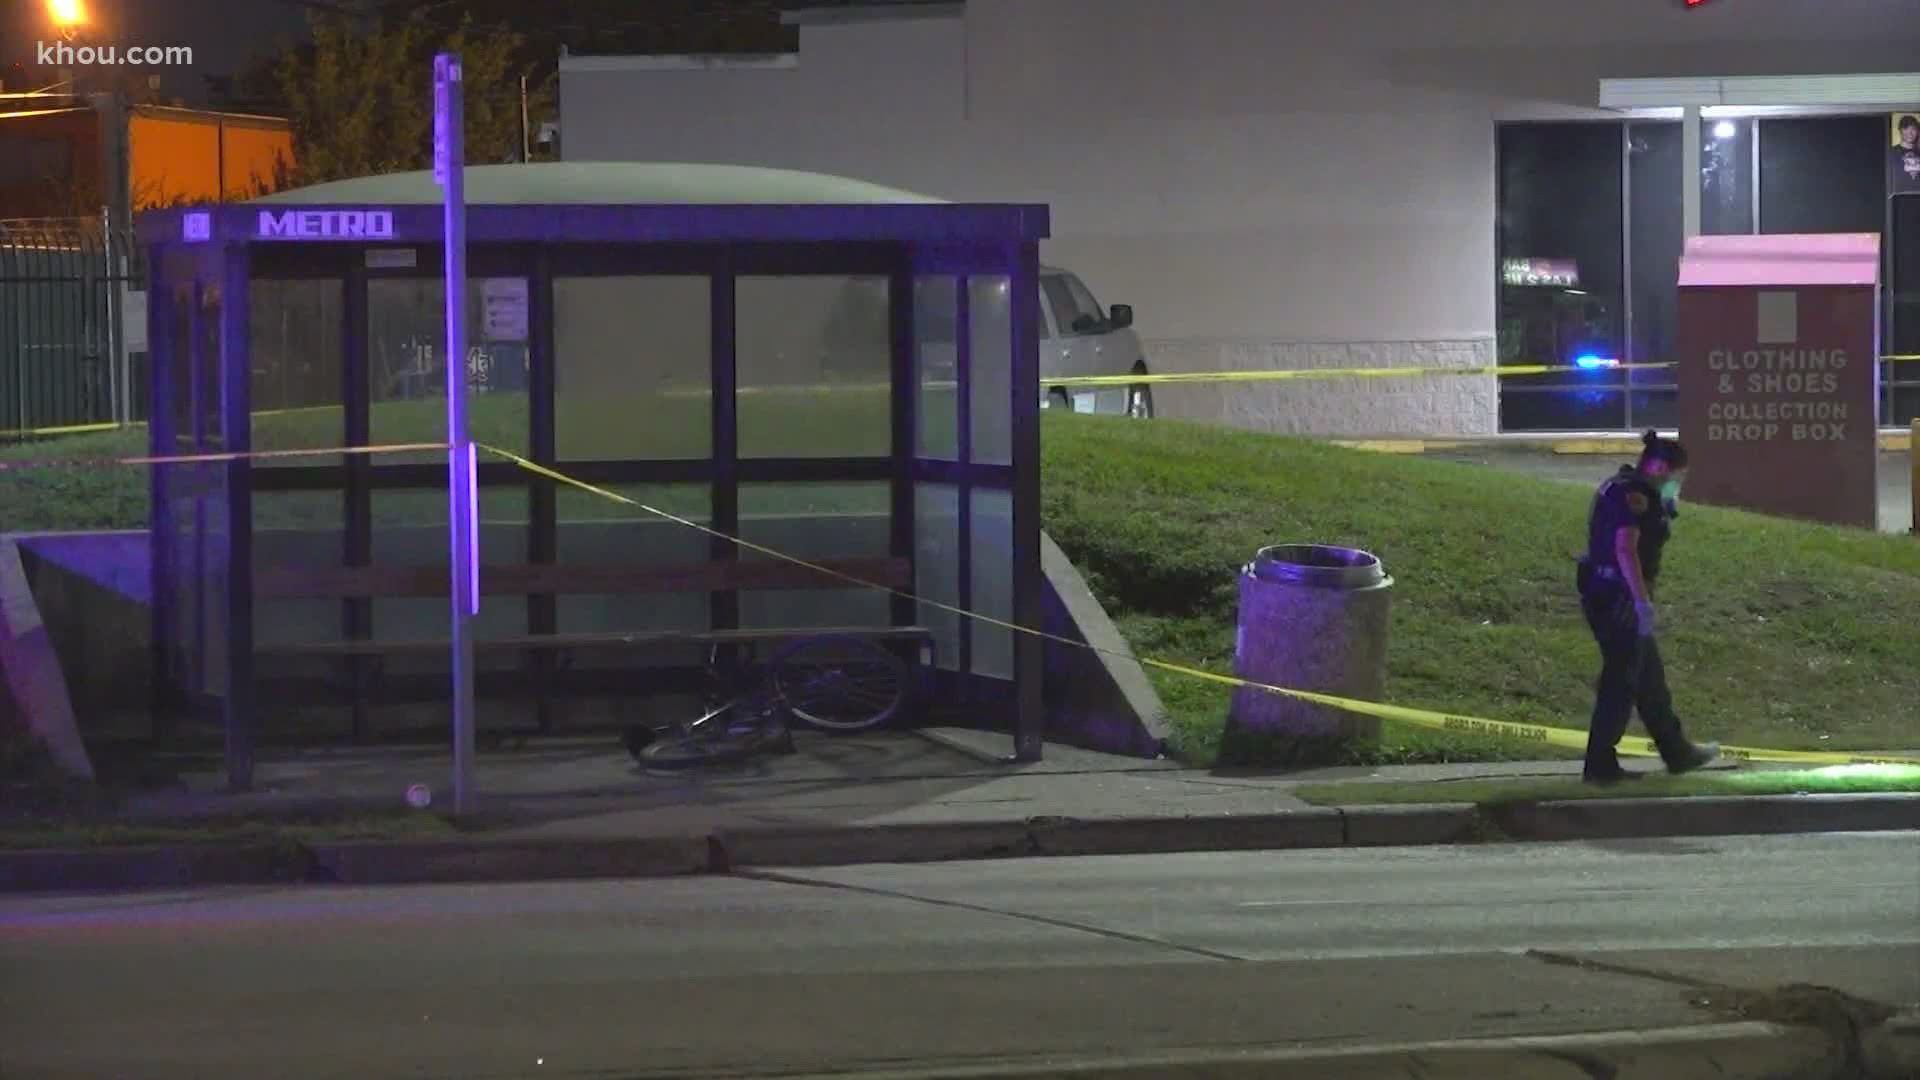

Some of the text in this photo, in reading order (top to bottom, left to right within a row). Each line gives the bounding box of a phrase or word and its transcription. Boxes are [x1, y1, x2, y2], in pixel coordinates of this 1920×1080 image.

[259, 210, 393, 237] METRO
[1708, 348, 1849, 370] CLOTHING
[1717, 372, 1838, 393] & SHOES
[1708, 402, 1848, 420] COLLECTION
[1708, 423, 1846, 441] DROP BOX
